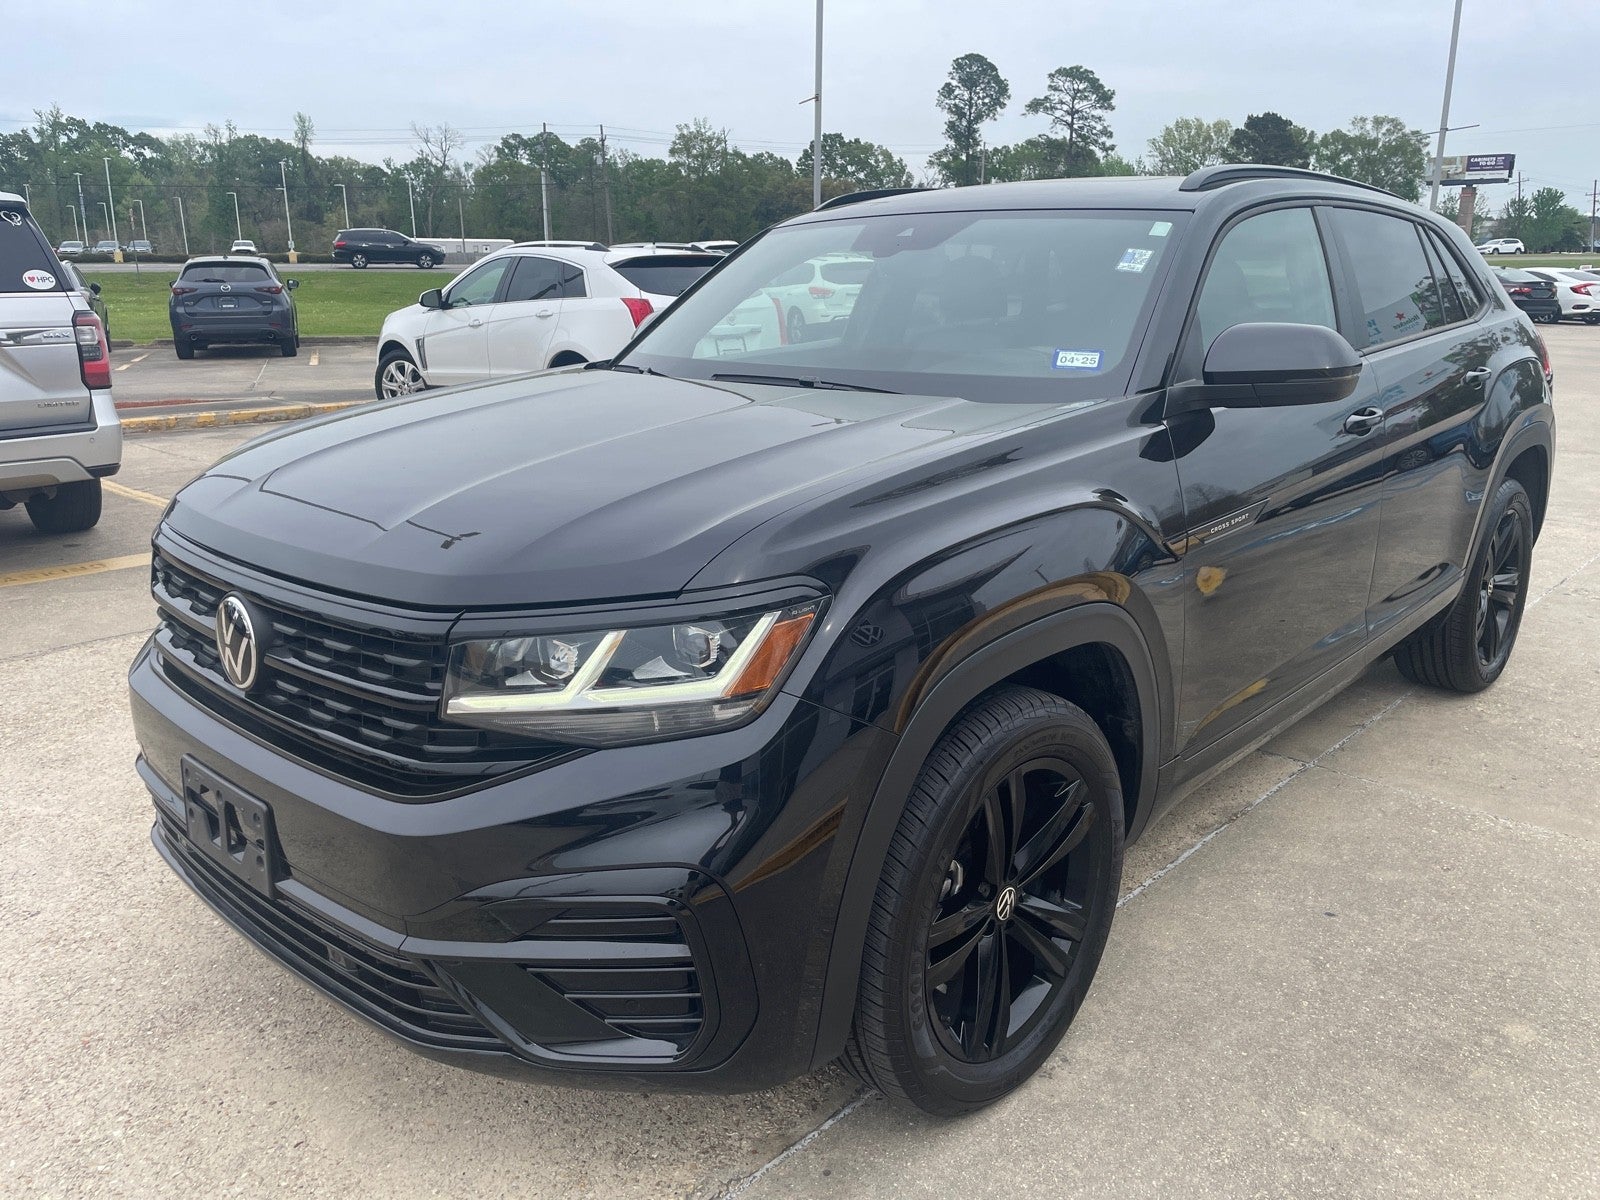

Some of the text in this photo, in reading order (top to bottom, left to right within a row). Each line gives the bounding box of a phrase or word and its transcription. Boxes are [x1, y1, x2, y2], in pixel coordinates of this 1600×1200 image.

[36, 276, 54, 284] HPC
[1210, 513, 1249, 534] CROSS SPORT
